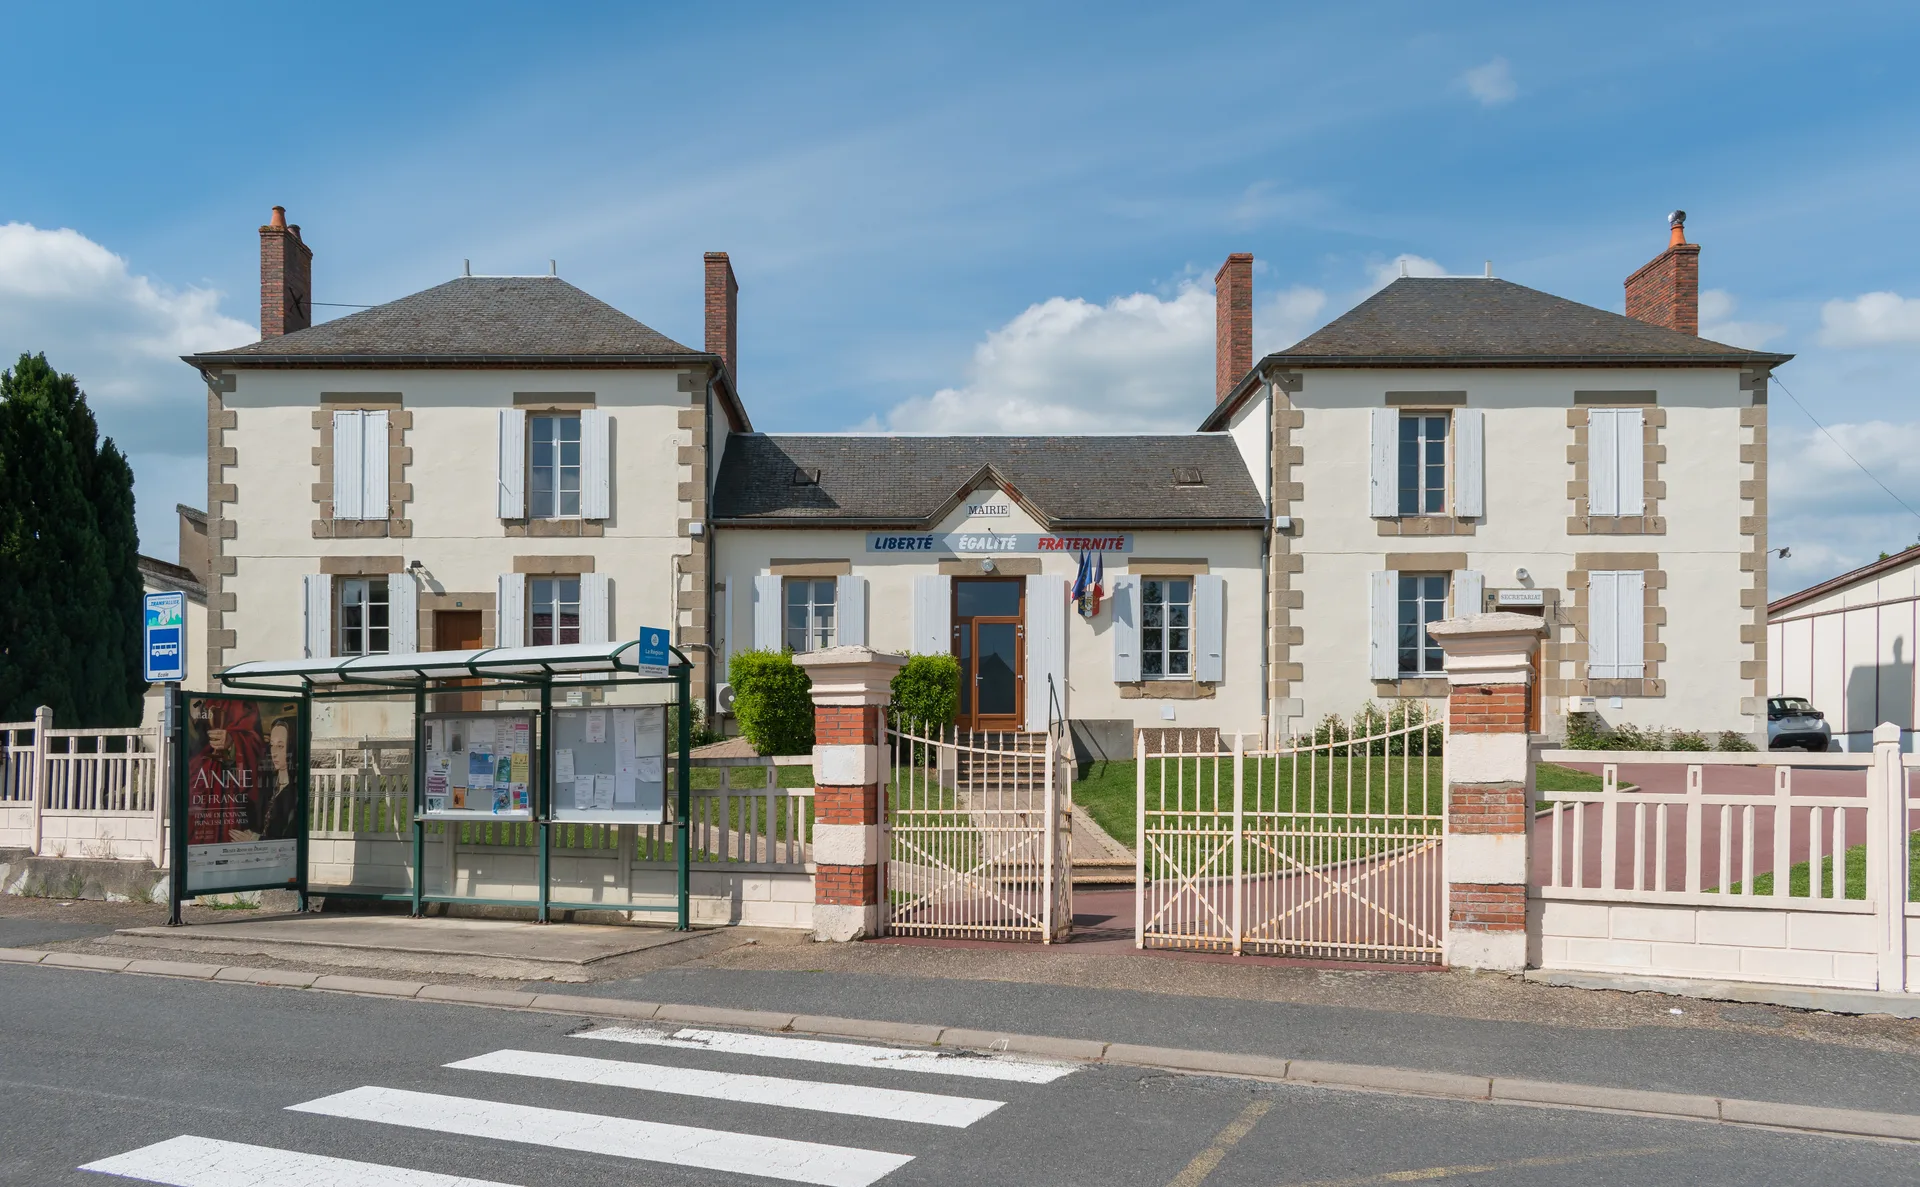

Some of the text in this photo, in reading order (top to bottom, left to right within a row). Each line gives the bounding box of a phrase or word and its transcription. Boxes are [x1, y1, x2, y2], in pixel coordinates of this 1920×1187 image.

[968, 505, 1008, 515] MAIRIE
[874, 534, 1125, 551] LIBERTÉ ÉGALITÉ FRATERNITÉ
[193, 767, 254, 789] ANNE
[192, 793, 249, 805] DE FRANCE
